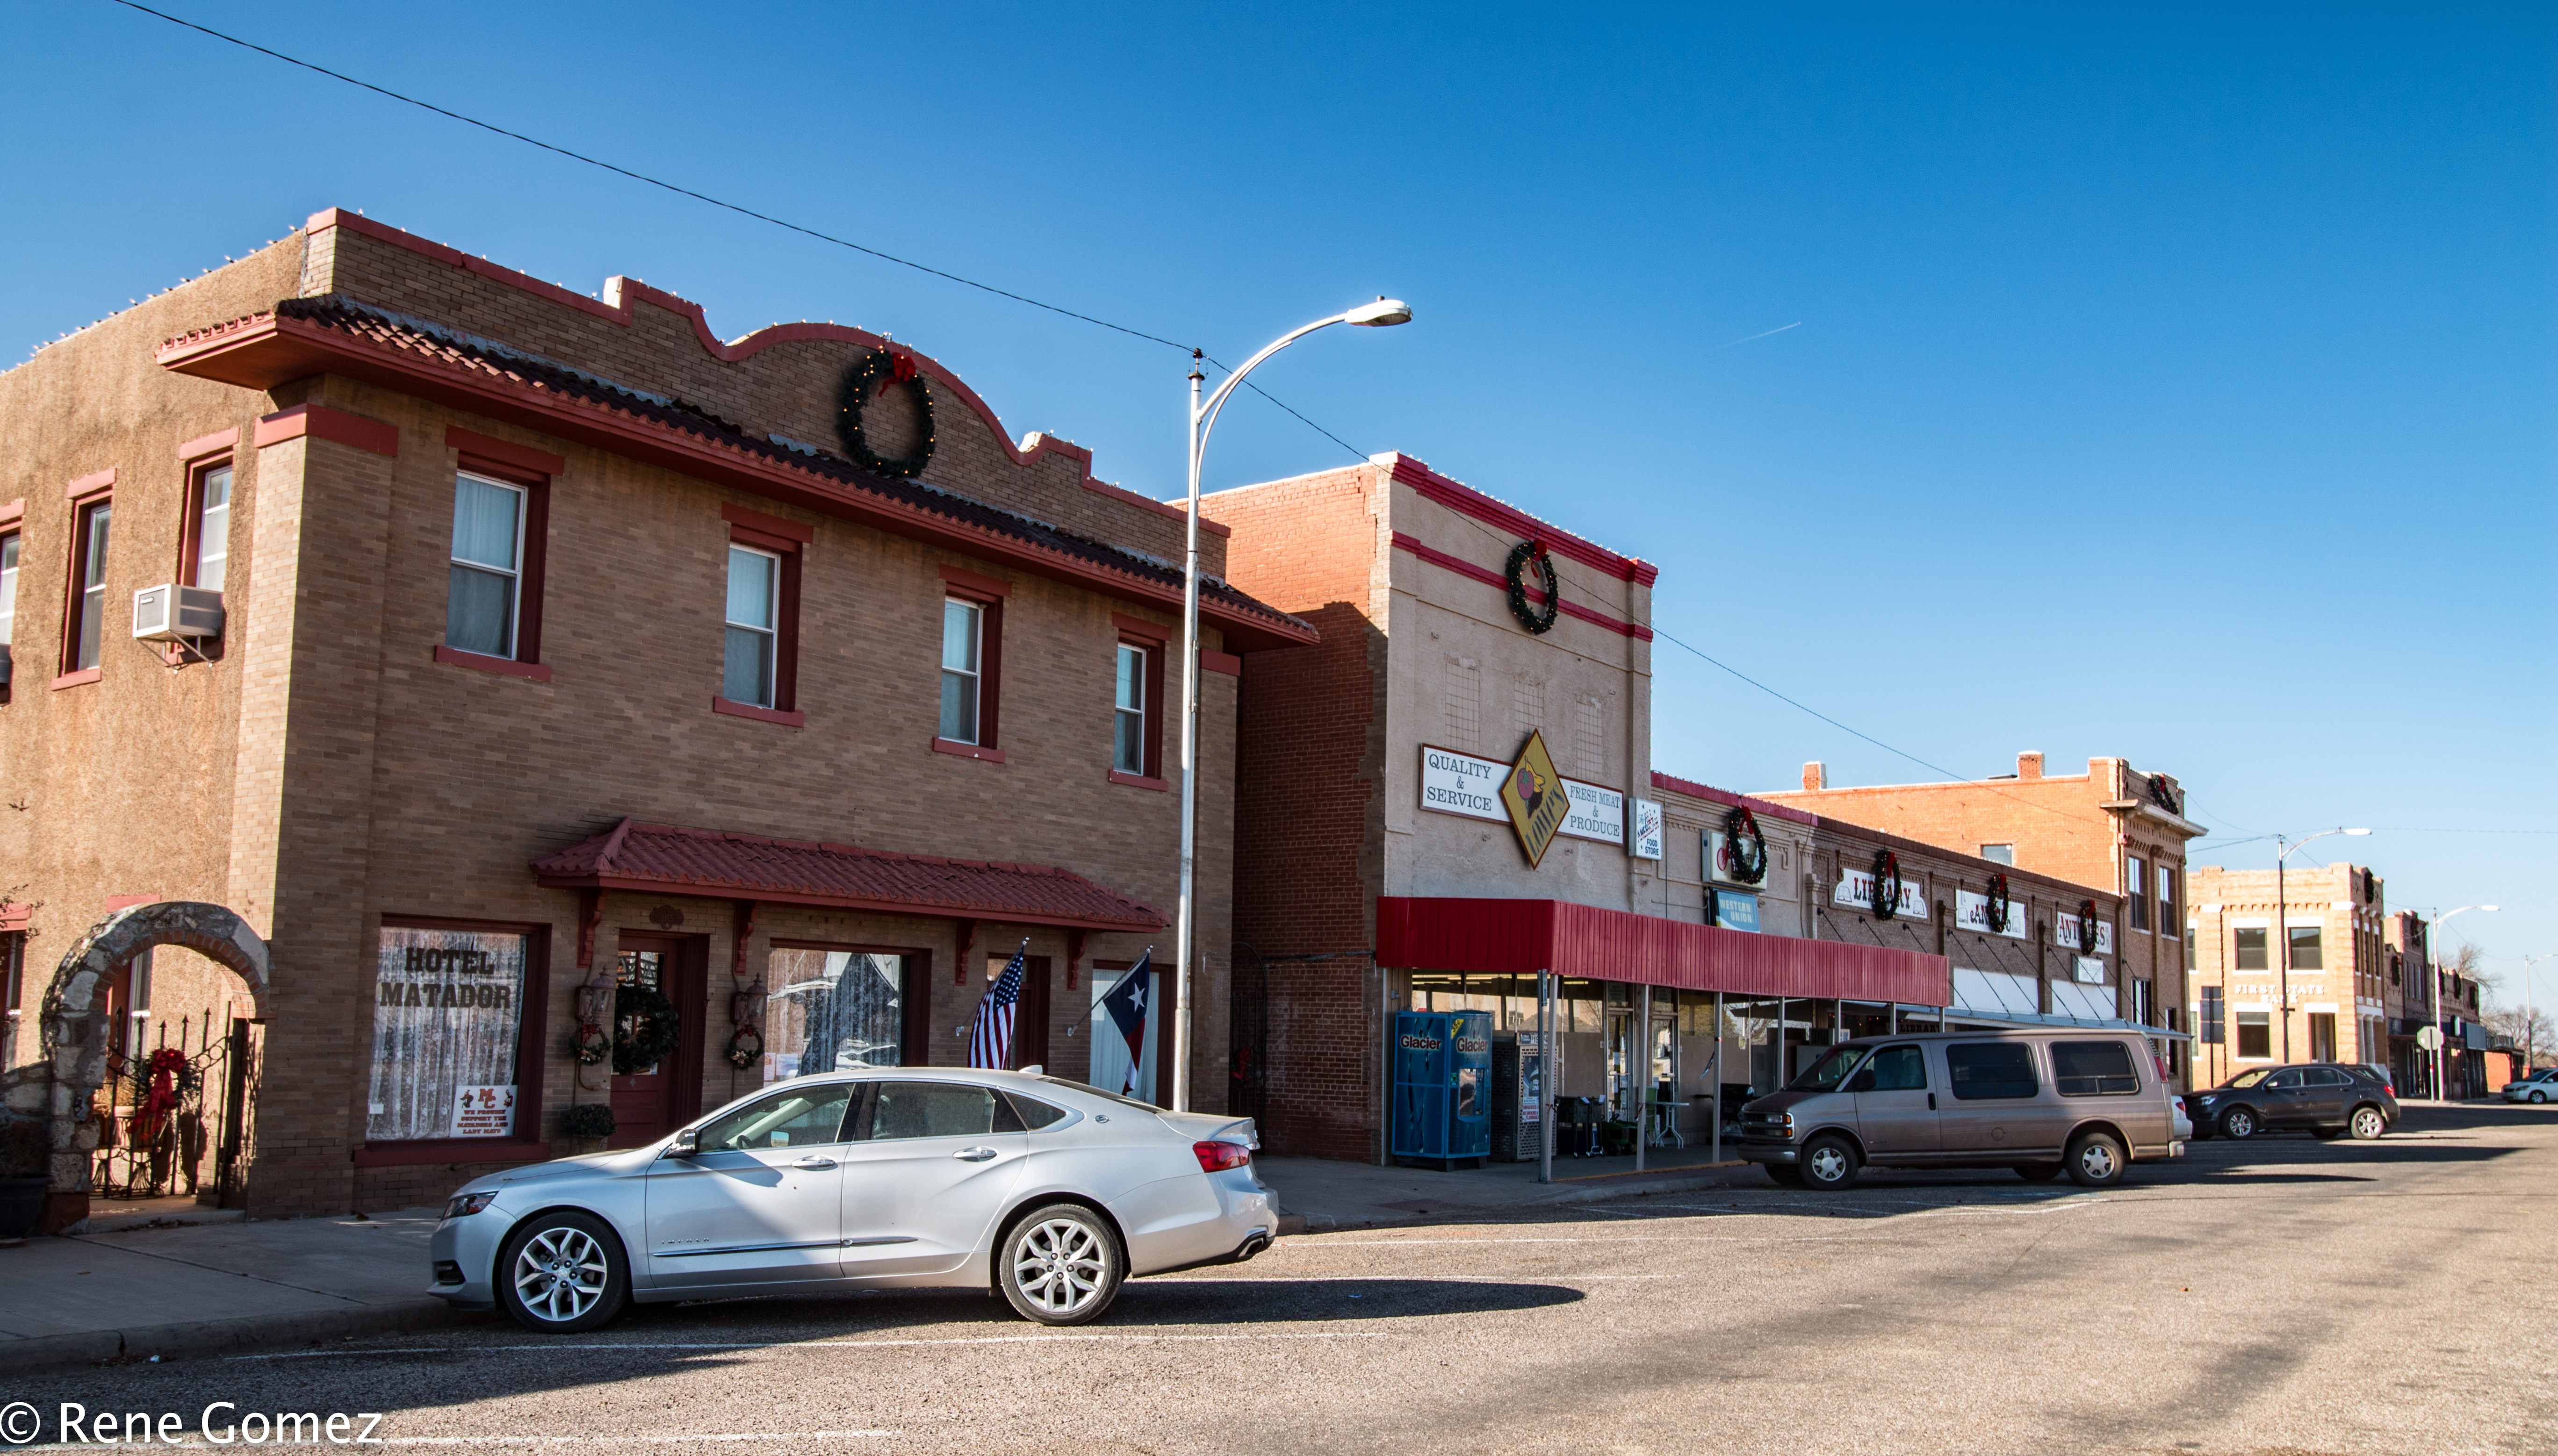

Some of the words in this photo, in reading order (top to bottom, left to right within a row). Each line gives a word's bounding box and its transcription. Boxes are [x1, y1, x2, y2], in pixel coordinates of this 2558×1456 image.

[1429, 754, 1491, 779] QUALITY
[1456, 776, 1464, 789] &
[1427, 787, 1492, 811] SERVICE
[1570, 785, 1597, 803] FRESH
[1599, 792, 1620, 808] MEAT
[1593, 805, 1599, 818] &
[1570, 815, 1619, 837] PRODUCE
[1647, 839, 1657, 847] FOOD
[1645, 846, 1659, 856] STORE
[1854, 877, 1911, 909] LIBARY
[1719, 899, 1751, 912] WESTERN
[1730, 911, 1752, 923] UNION
[405, 947, 495, 975] HOTEL
[380, 983, 511, 1009] MATADOR
[2234, 985, 2276, 994] FIRST
[2261, 994, 2299, 1004] BAK
[1451, 1020, 1460, 1033] 35¢
[1400, 1035, 1441, 1050] Glacier
[1457, 1037, 1487, 1052] Glacier
